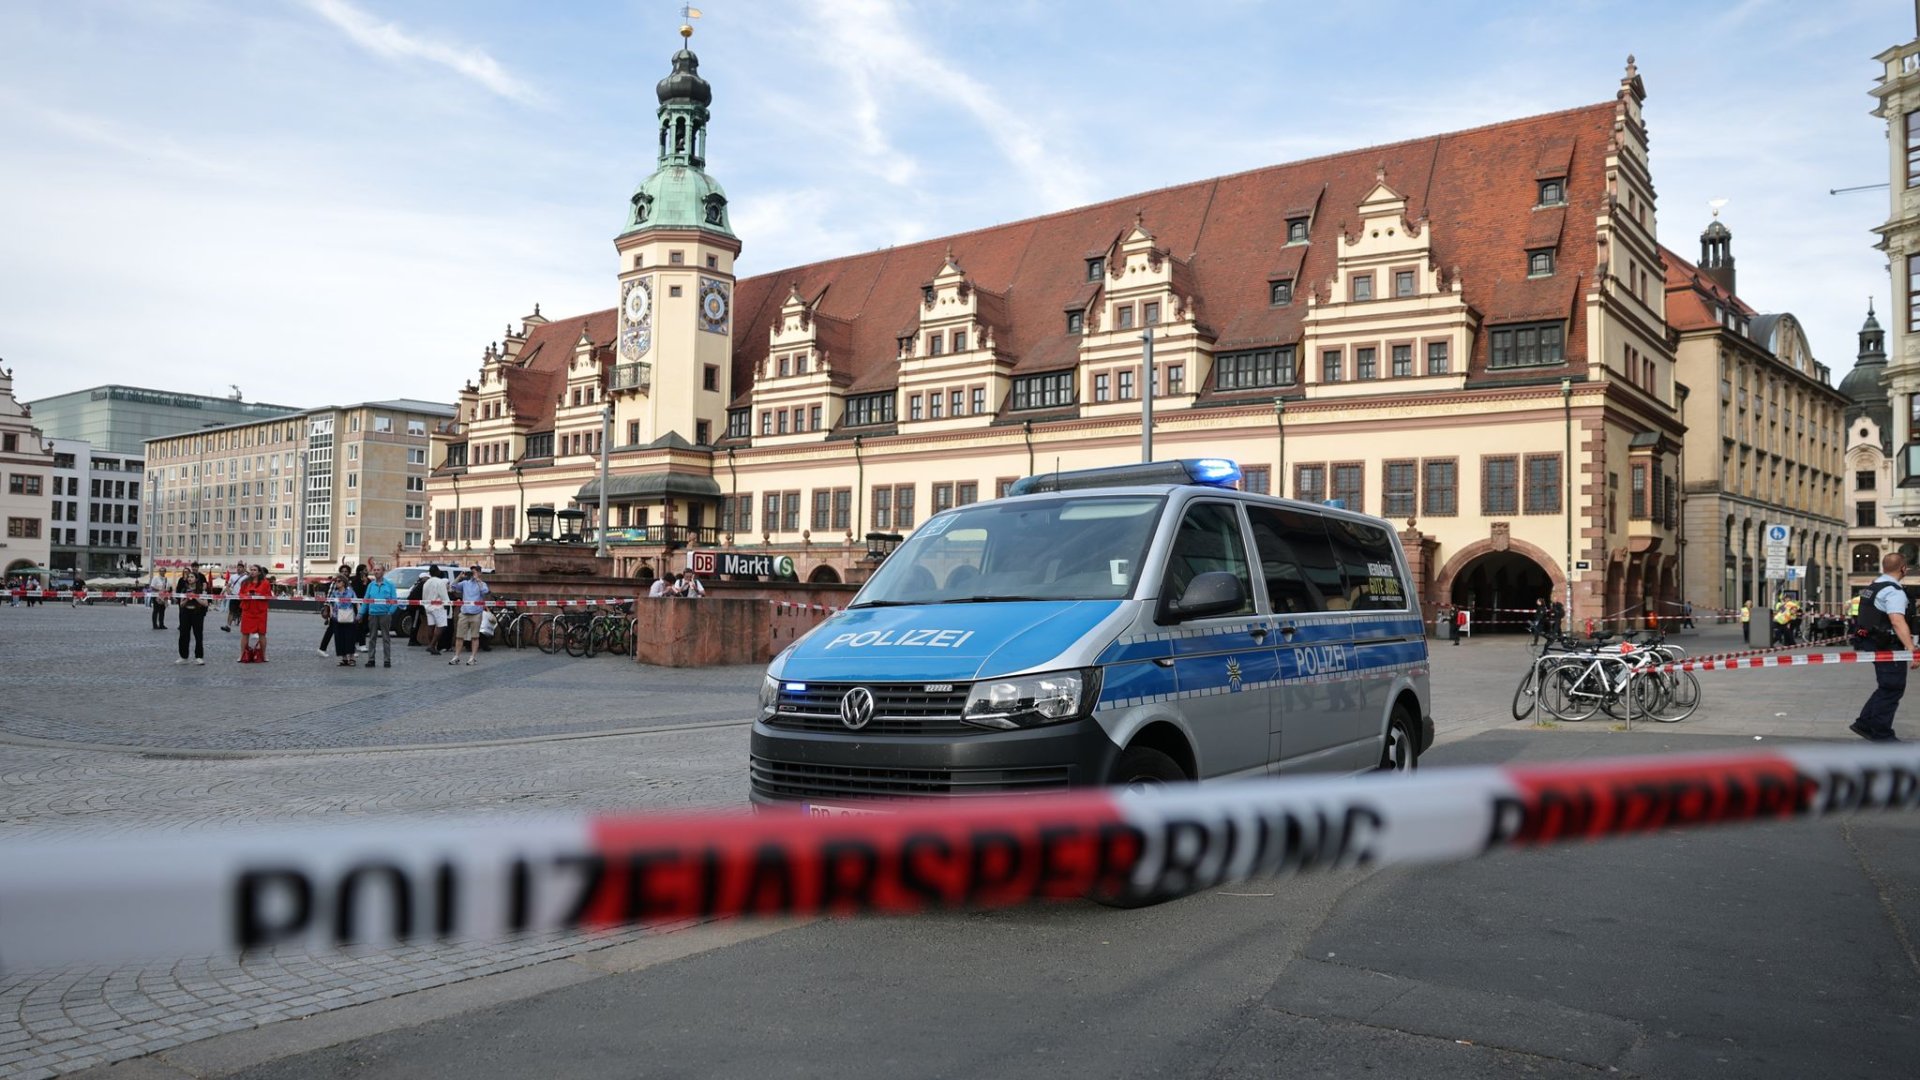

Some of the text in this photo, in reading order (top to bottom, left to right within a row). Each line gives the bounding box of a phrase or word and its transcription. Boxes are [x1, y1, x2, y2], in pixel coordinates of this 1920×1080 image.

[695, 555, 713, 571] DB
[724, 554, 770, 575] Markt
[781, 558, 792, 575] S
[824, 629, 975, 651] POLIZEI
[1293, 645, 1347, 676] POLIZEI
